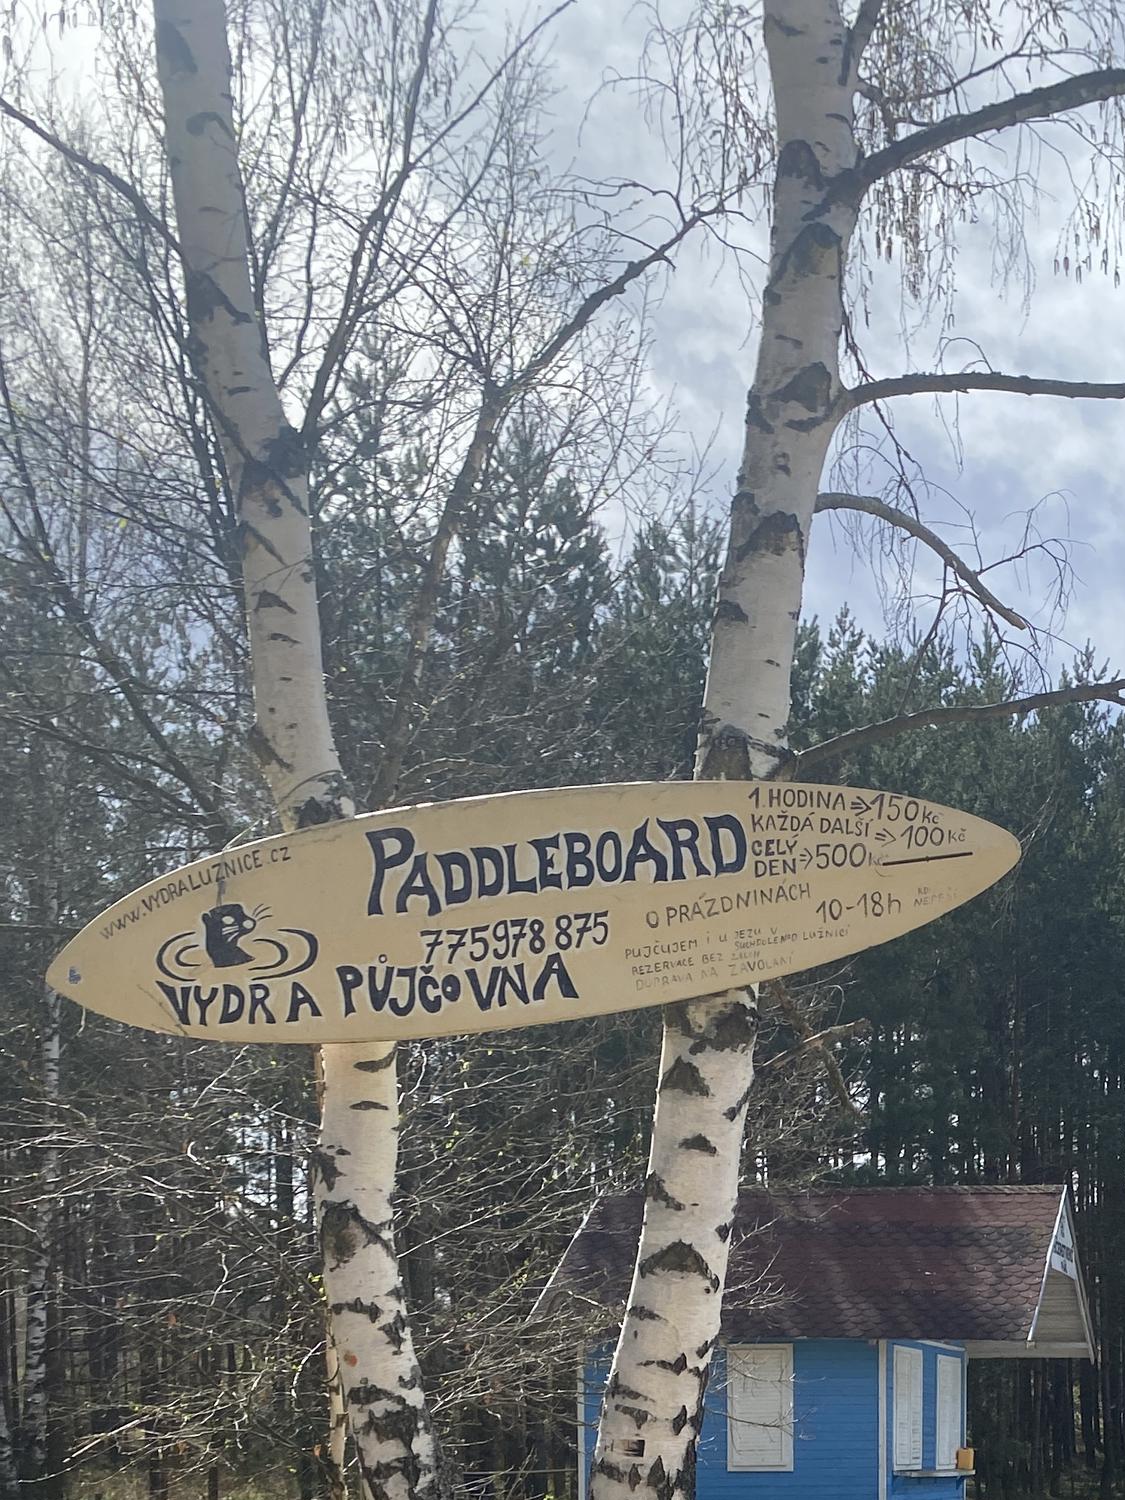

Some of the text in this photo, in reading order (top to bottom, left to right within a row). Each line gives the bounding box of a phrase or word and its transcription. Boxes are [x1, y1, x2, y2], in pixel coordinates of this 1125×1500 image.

[870, 794, 919, 821] 150
[751, 810, 816, 833] KAŽDÁ
[820, 817, 874, 837] DALŠÍ
[901, 825, 944, 849] 100
[752, 834, 799, 857] CELÝ
[365, 814, 748, 917] PADDLEBOARD
[755, 858, 797, 878] DEN
[816, 843, 867, 869] 500
[646, 879, 811, 928] O PRÁZDNINÁCH
[702, 953, 723, 964] BEZ
[155, 952, 579, 1026] VYDRA PŮJČOVNA
